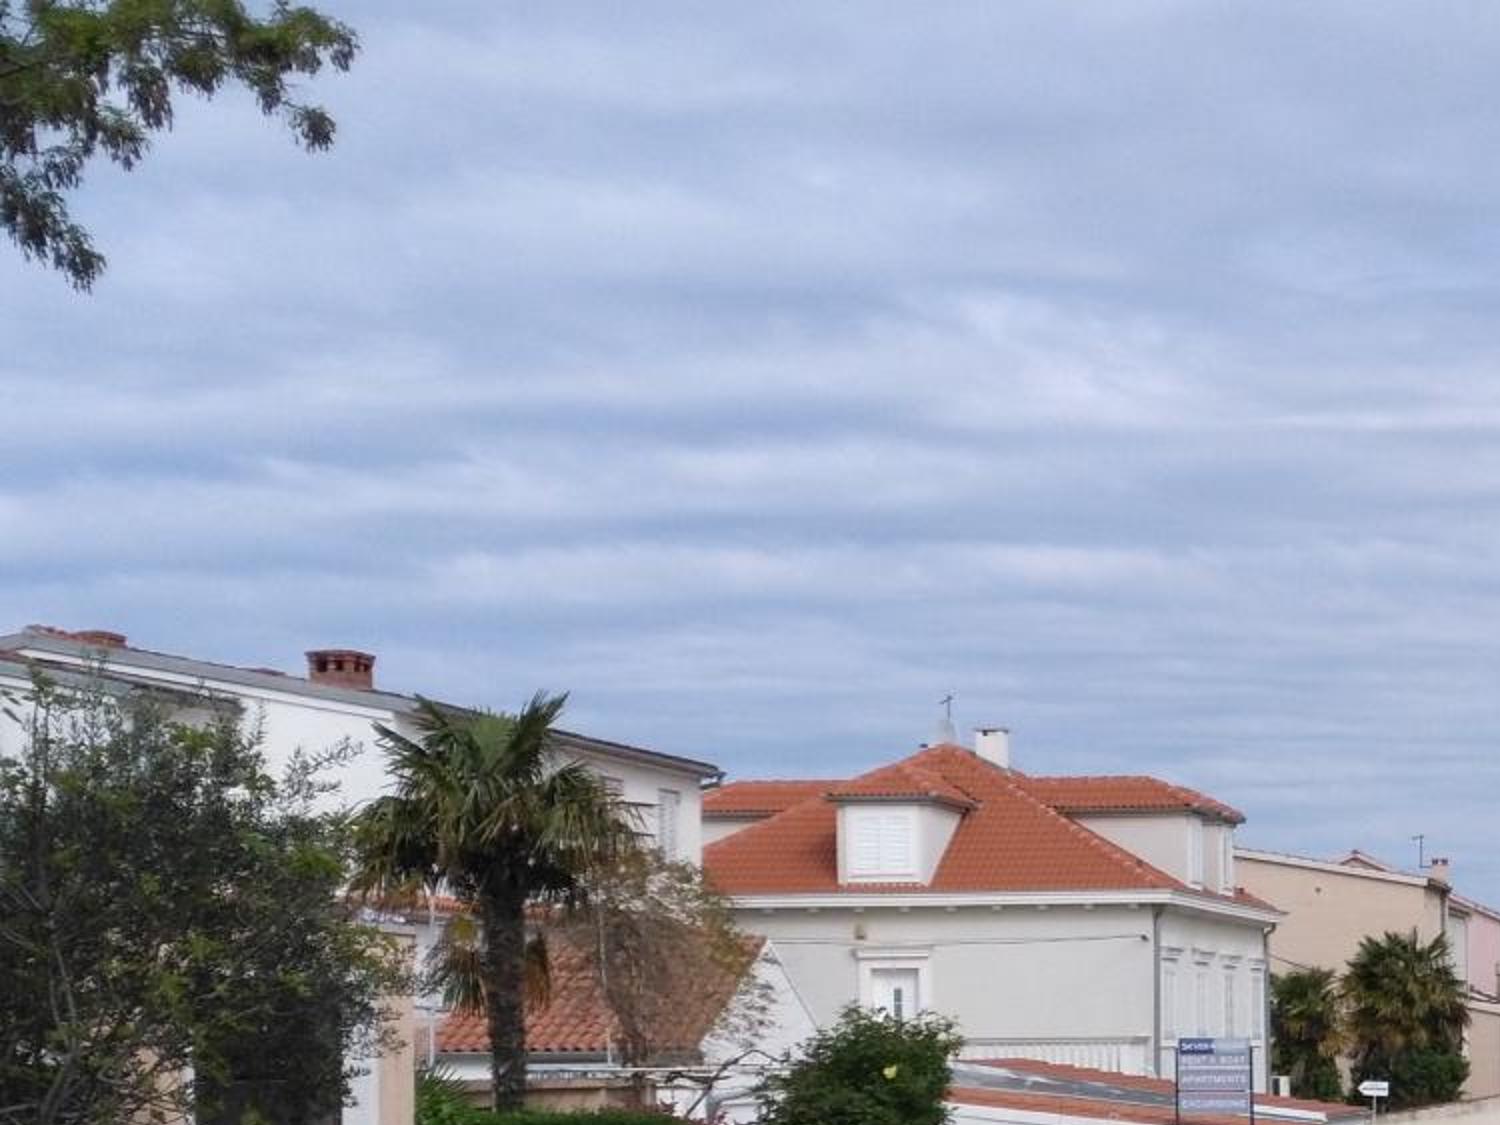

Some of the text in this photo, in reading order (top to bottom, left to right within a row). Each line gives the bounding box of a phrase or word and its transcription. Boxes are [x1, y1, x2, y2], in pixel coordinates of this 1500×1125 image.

[1181, 1055, 1207, 1065] RENT
[1219, 1055, 1246, 1065] BOAT
[1181, 1074, 1247, 1083] APARTMENTS
